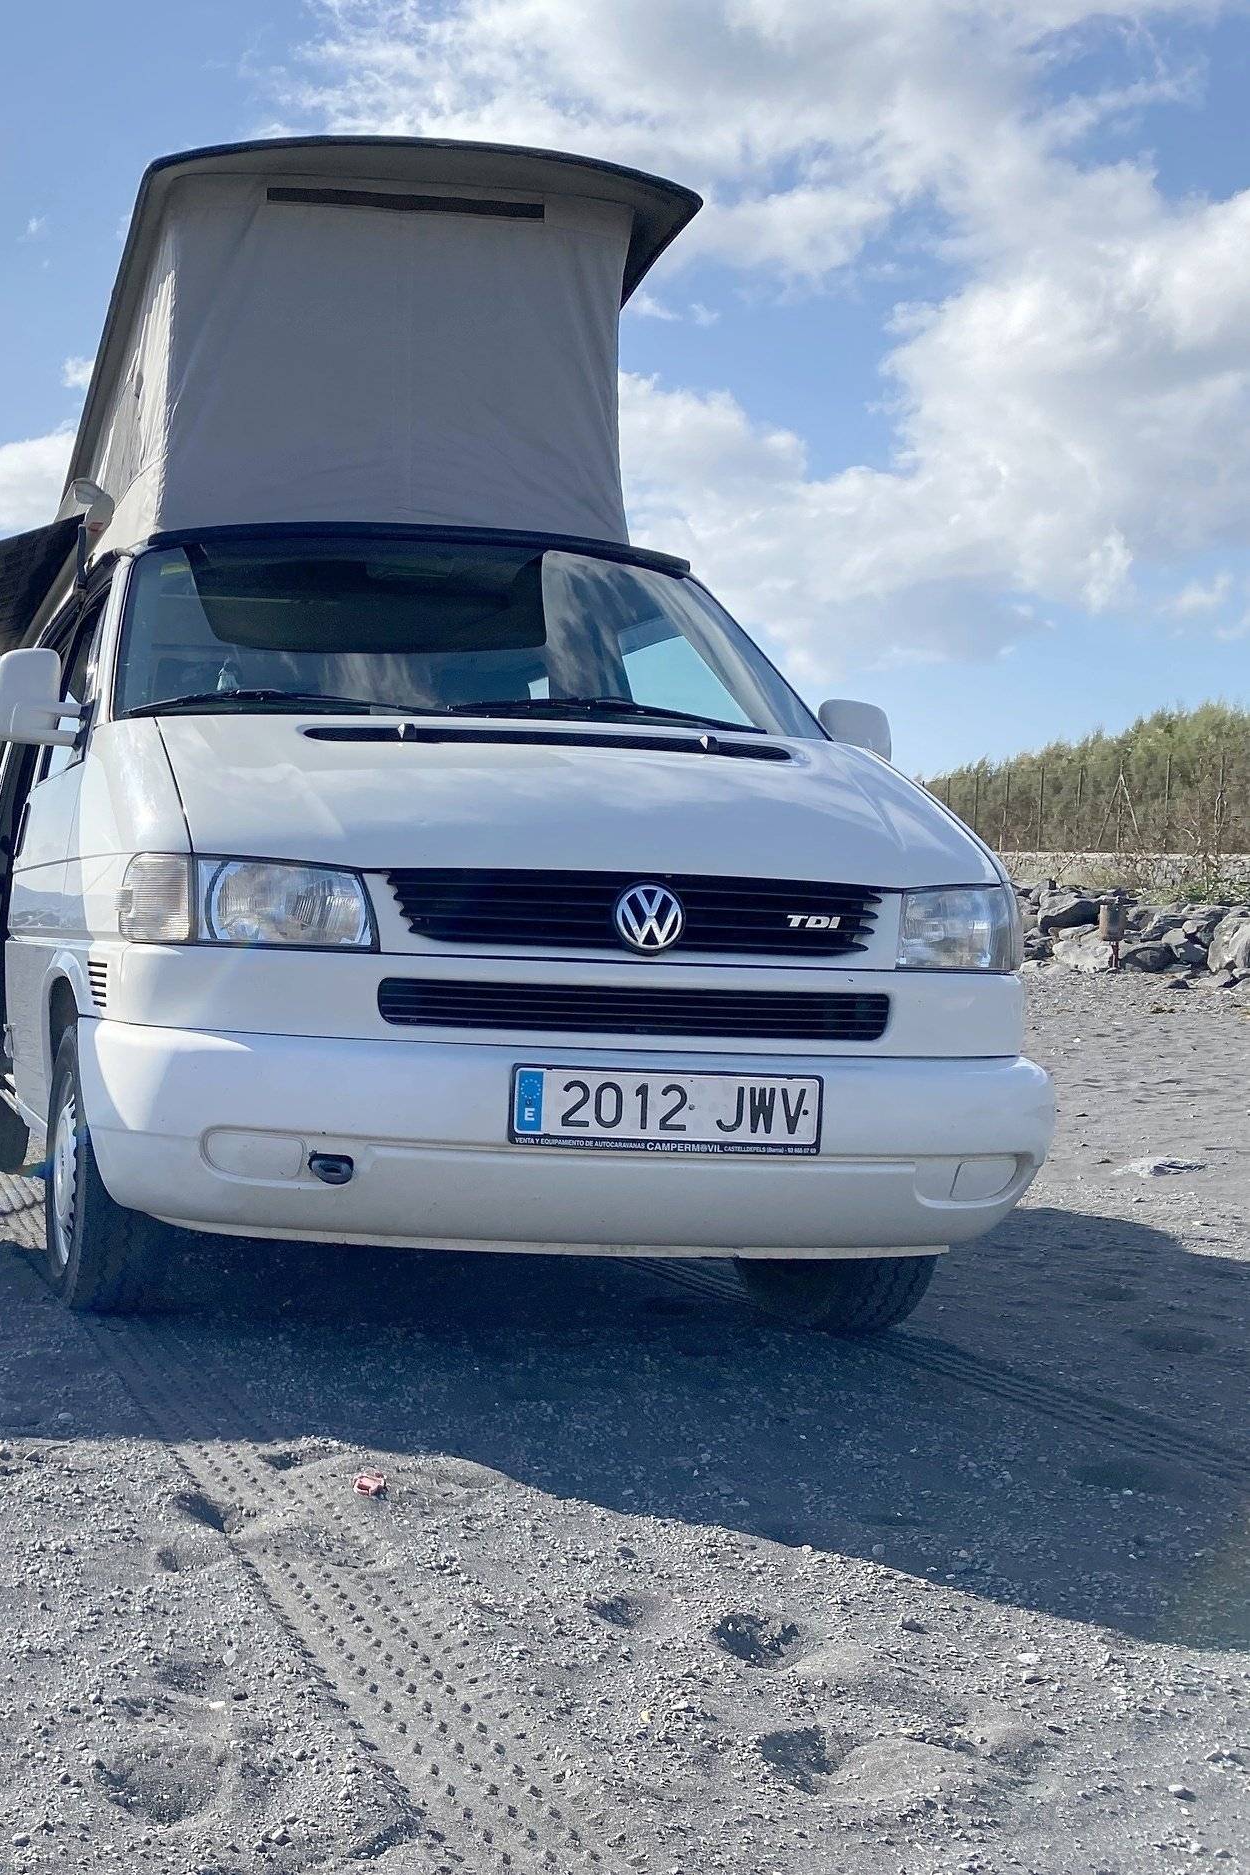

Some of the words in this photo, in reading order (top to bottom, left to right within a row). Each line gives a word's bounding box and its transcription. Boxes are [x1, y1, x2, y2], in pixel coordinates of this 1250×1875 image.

[616, 885, 683, 950] VW
[787, 914, 841, 929] TDI
[523, 1107, 535, 1122] E
[561, 1079, 689, 1132] 2012
[715, 1086, 807, 1135] JWV
[540, 1139, 585, 1147] EQUIPAMIENTO
[594, 1141, 645, 1149] AUTOCARAVANAS
